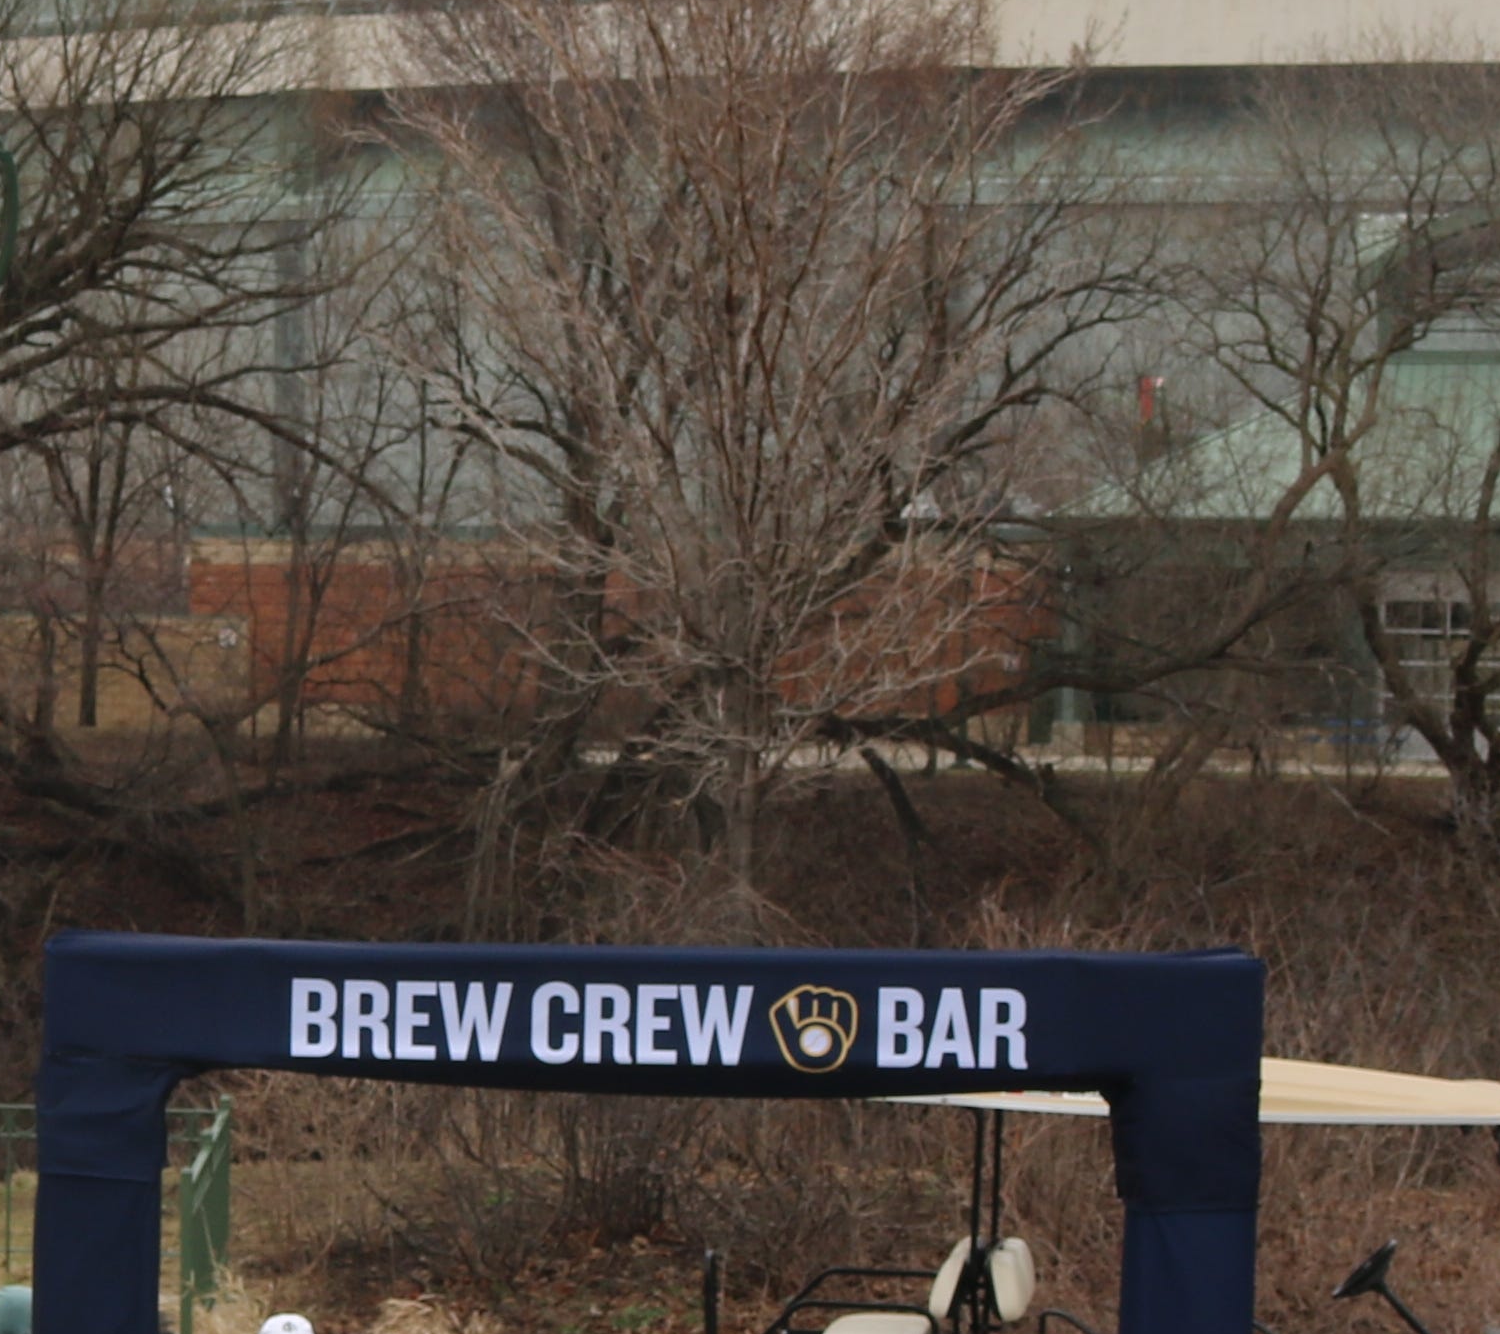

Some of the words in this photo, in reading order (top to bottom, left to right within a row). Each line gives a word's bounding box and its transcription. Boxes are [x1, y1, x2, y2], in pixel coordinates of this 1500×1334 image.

[290, 978, 513, 1061] BREW
[531, 981, 754, 1065] CREW
[877, 987, 1029, 1070] BAR
